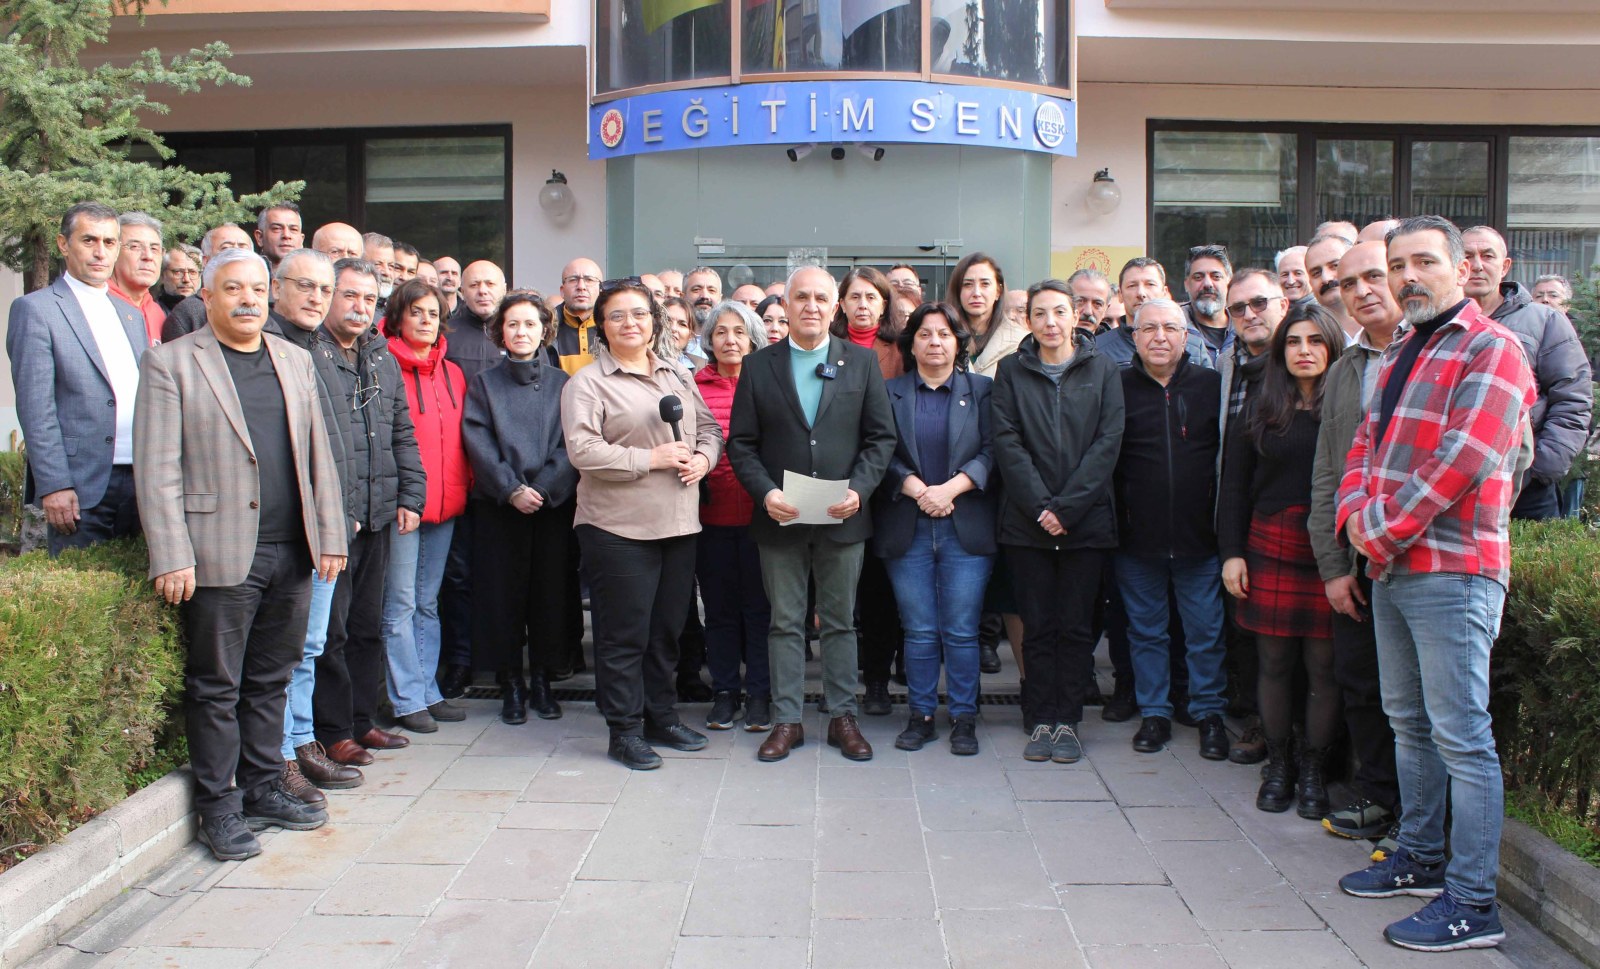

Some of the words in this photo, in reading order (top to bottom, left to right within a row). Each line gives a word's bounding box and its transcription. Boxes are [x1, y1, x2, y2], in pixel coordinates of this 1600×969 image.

[643, 93, 874, 142] EĞİTİM
[910, 98, 1022, 139] SEN
[1037, 119, 1065, 135] KESK
